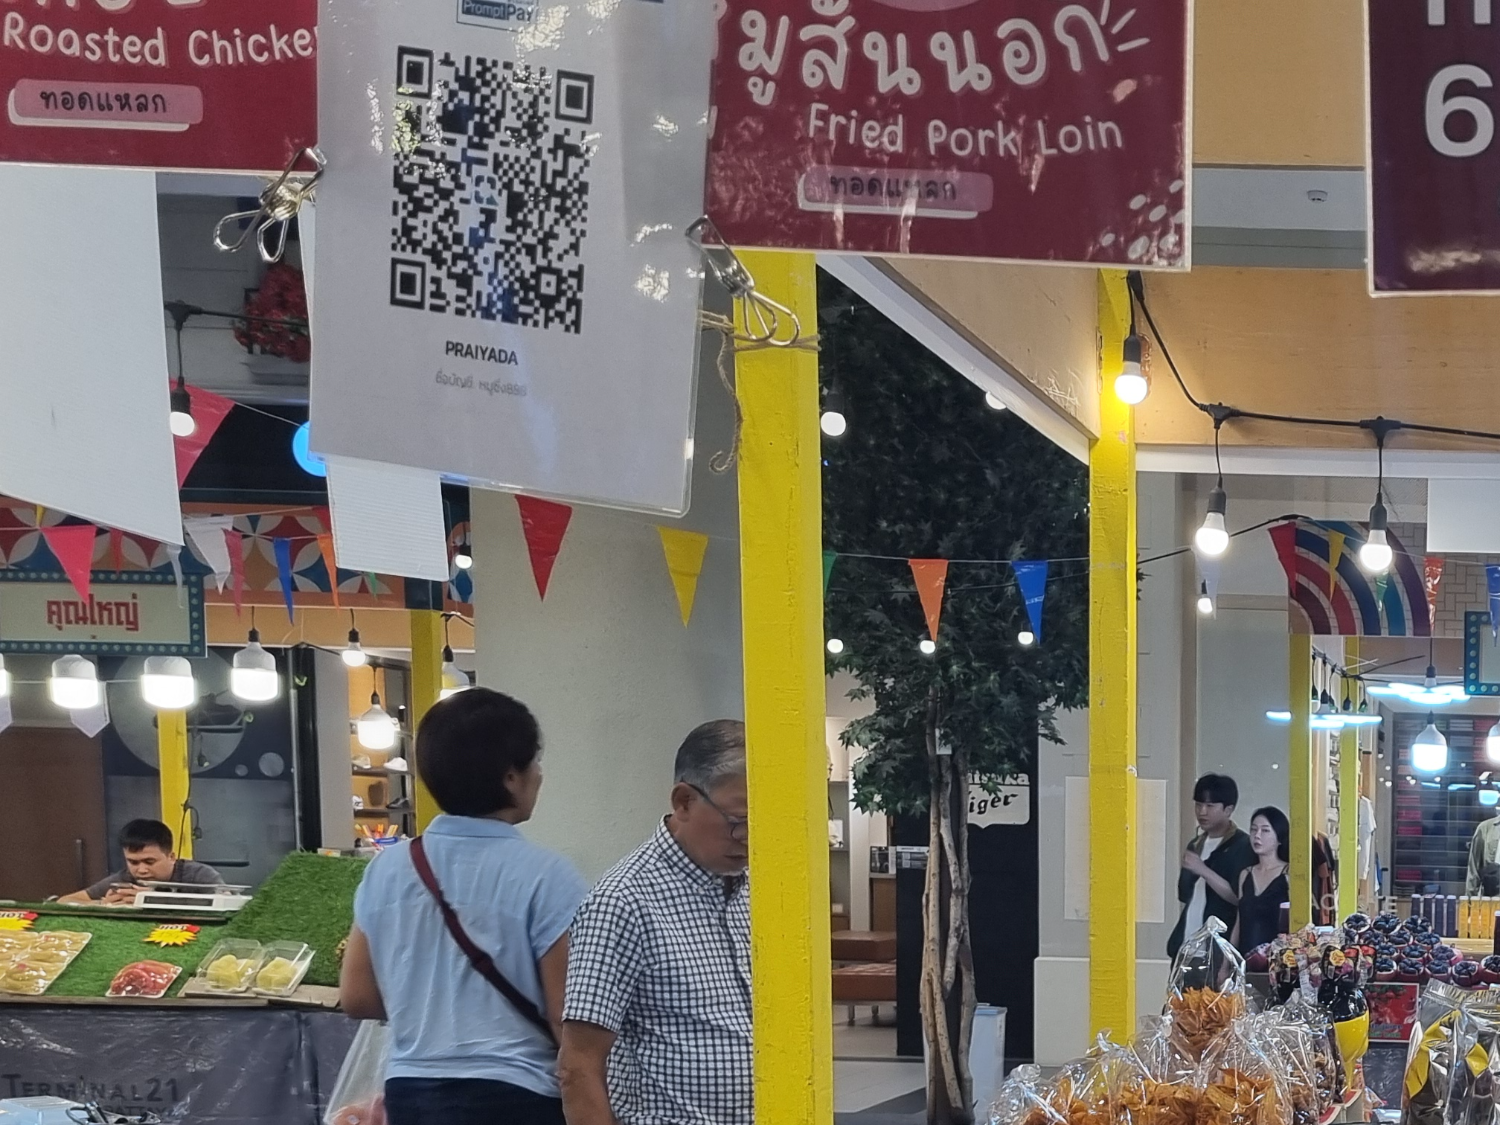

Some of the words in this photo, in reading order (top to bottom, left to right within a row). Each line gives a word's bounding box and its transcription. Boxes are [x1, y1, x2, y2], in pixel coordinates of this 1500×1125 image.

[3, 11, 167, 67] Roasted
[187, 23, 318, 66] Chicke
[39, 90, 168, 113] ทอดแหลก
[808, 103, 904, 154] Fried
[928, 118, 1018, 157] Pork
[1037, 115, 1123, 156] Loin
[445, 340, 519, 366] PRAIYADA
[967, 791, 1019, 815] iger
